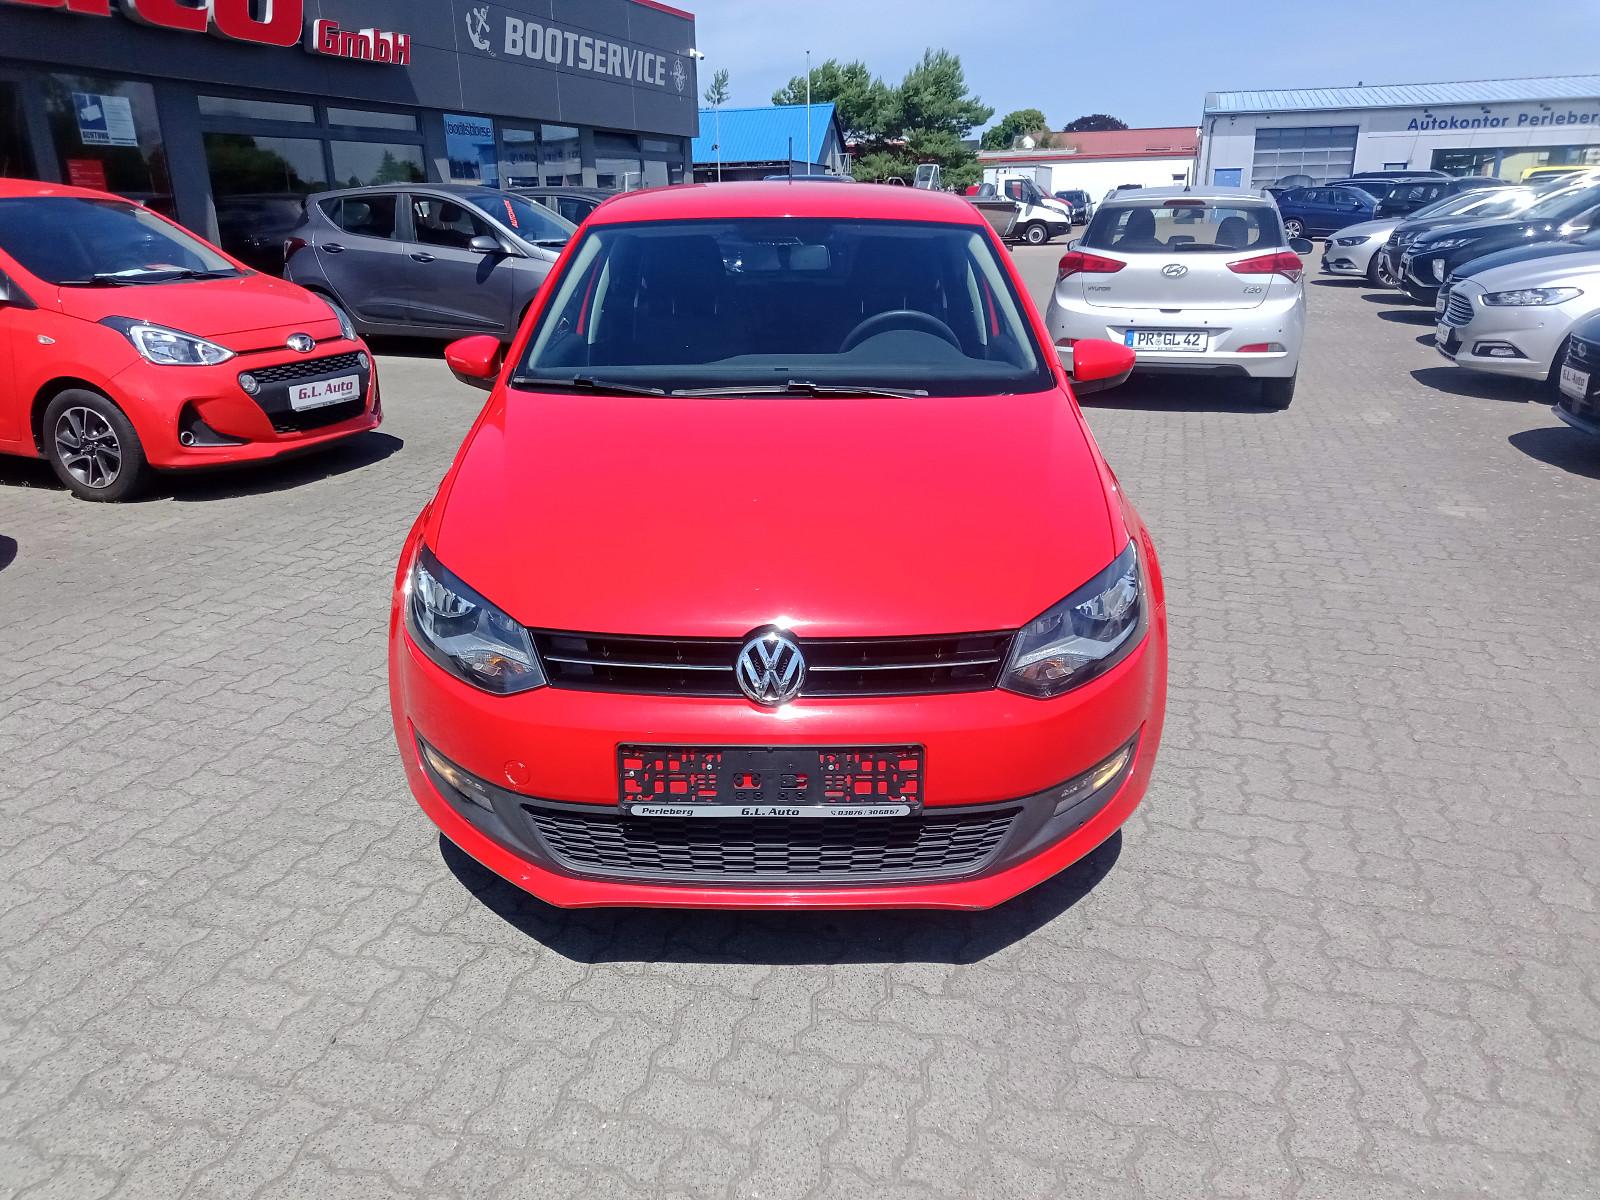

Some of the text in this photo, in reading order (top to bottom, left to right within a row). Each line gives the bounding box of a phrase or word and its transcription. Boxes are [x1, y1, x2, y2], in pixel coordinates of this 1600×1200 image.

[313, 19, 410, 65] GmbH
[504, 16, 666, 86] BOOTSERVICE
[1407, 110, 1600, 131] Autokontor Perleber
[1137, 332, 1200, 347] PR GL 42
[298, 386, 322, 400] G.L.
[325, 381, 353, 395] Auto
[641, 807, 694, 817] Perleberg
[741, 807, 766, 816] G.L.
[768, 807, 800, 816] Auto
